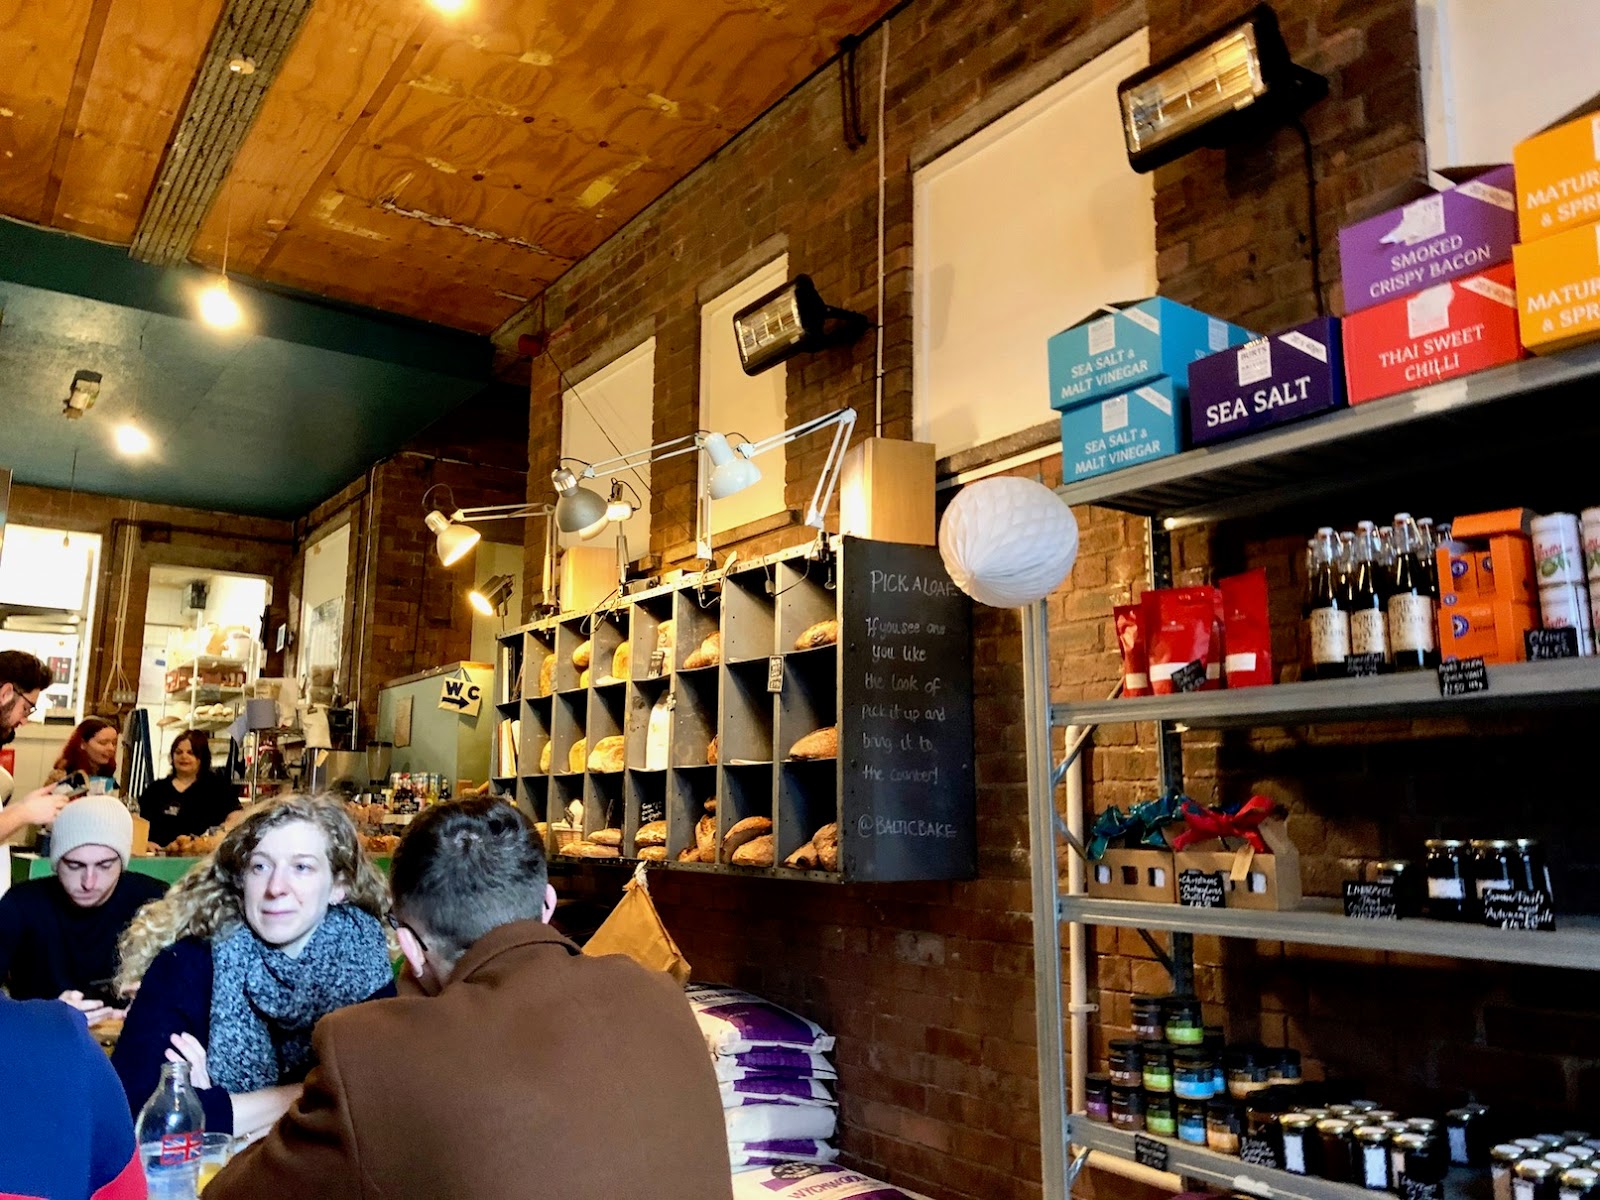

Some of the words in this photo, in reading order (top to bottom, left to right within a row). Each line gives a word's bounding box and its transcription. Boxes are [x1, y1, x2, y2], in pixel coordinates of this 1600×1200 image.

[1540, 212, 1552, 227] &
[1390, 234, 1463, 271] SMOKED
[1369, 267, 1425, 298] CRISPY
[1430, 245, 1491, 279] BACON
[1542, 319, 1554, 332] &
[1379, 344, 1419, 368] THAI
[1423, 323, 1485, 356] SWEET
[1071, 361, 1093, 378] SEA
[1096, 349, 1125, 368] SALT
[1128, 349, 1135, 359] &
[1405, 353, 1460, 381] CHILLI
[1060, 379, 1092, 399] MALT
[1096, 359, 1149, 386] VINEGAR
[1206, 398, 1249, 427] SEA
[1254, 375, 1311, 414] SALT
[1084, 438, 1106, 455] SEA
[1109, 429, 1137, 447] SALT
[1140, 429, 1148, 439] &
[1075, 457, 1106, 475] MALT
[1109, 440, 1161, 464] VINEGAR
[870, 570, 909, 593] PICK
[912, 576, 921, 591] A
[923, 577, 959, 596] LOAF
[865, 617, 880, 638] If
[880, 621, 899, 640] you
[901, 622, 920, 634] see
[926, 622, 946, 635] one
[872, 644, 895, 663] you
[903, 645, 927, 662] like
[446, 681, 480, 700] WC
[865, 671, 885, 689] the
[891, 673, 918, 691] look
[924, 677, 941, 696] of
[862, 703, 886, 719] pick
[889, 703, 901, 719] it
[903, 709, 920, 722] up
[925, 707, 946, 722] and
[901, 733, 912, 750] it
[919, 735, 934, 752] to
[862, 764, 885, 780] the
[858, 814, 958, 838] @BALTICBAKE
